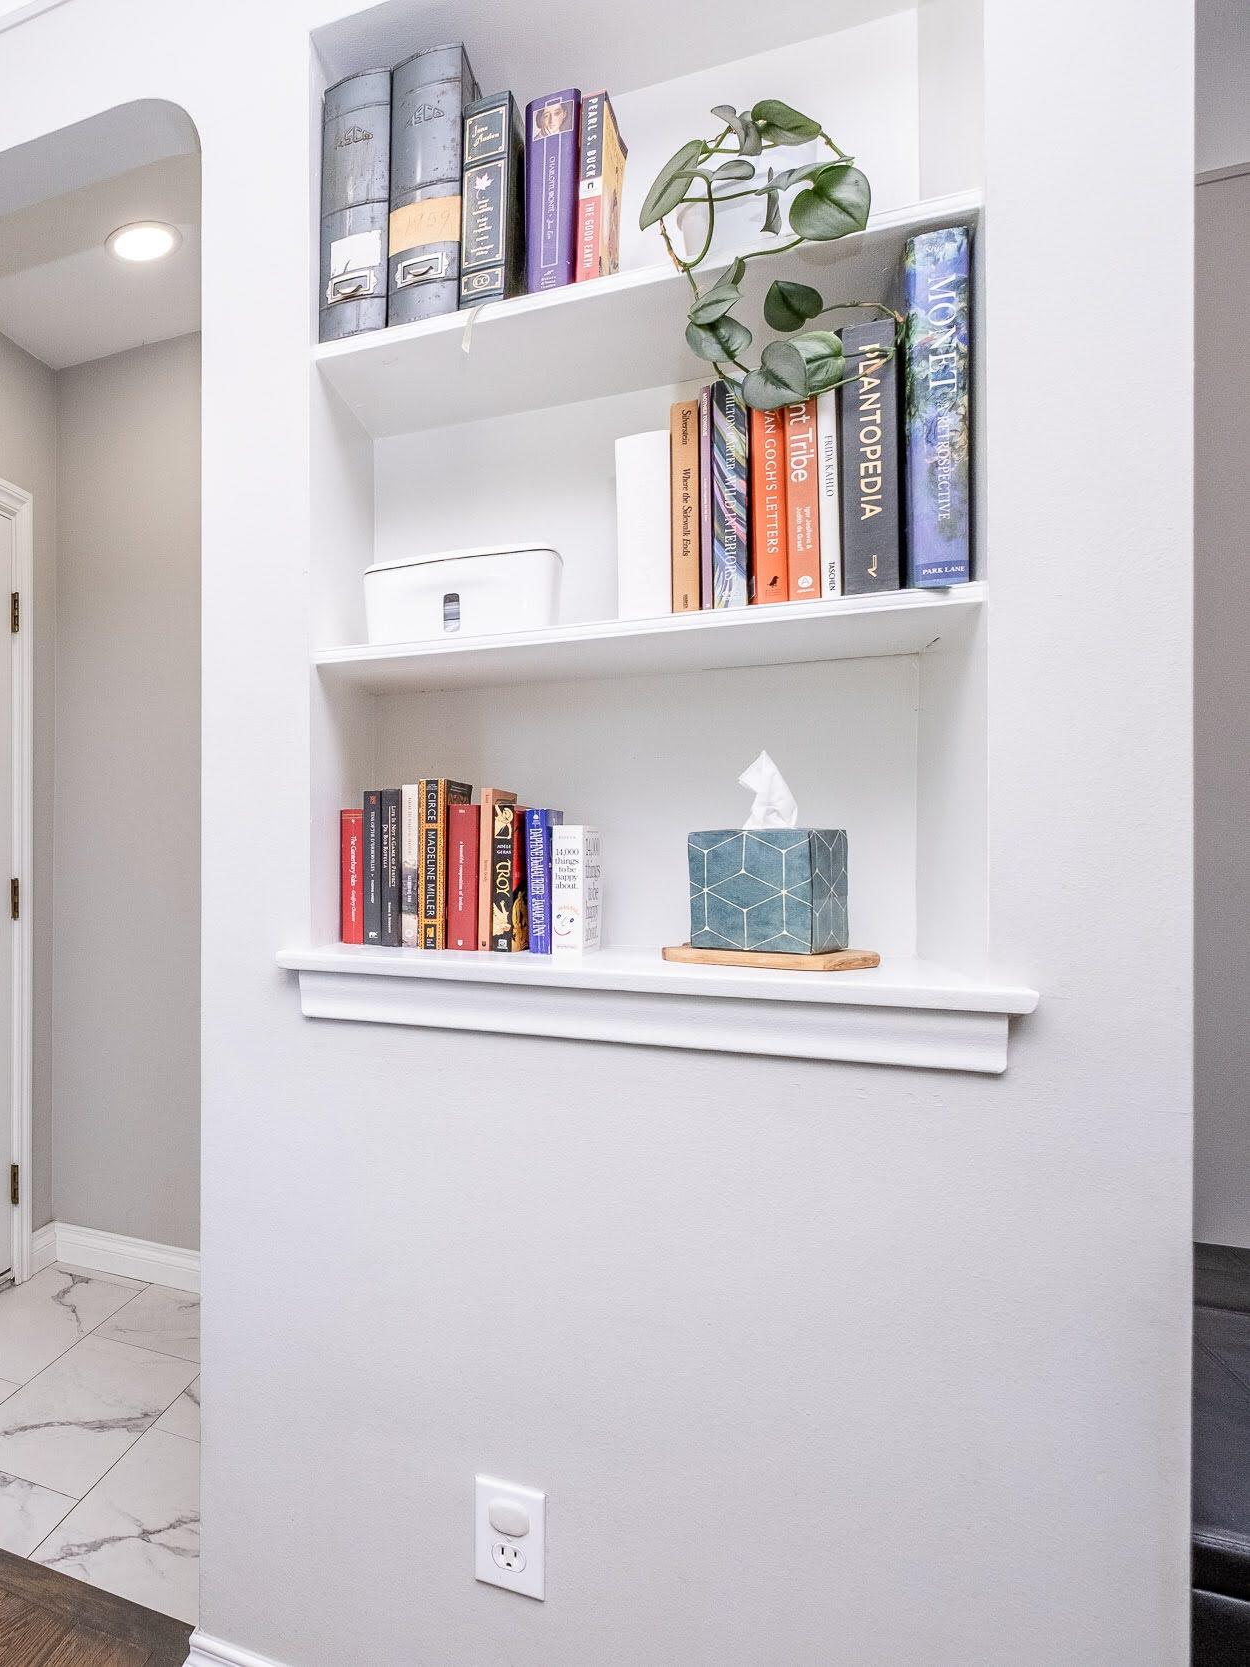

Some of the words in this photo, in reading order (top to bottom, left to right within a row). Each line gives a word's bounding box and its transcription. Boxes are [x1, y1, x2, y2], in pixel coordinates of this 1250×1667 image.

[587, 97, 598, 131] PEARL
[472, 125, 488, 138] Jane
[473, 132, 500, 147] Austen
[587, 136, 596, 146] S.
[585, 150, 596, 177] BUCK
[584, 203, 595, 218] THE
[584, 219, 594, 242] GOOD
[583, 244, 594, 269] EARTH
[927, 273, 957, 394] MONET
[725, 392, 735, 428] HILTON
[789, 403, 811, 426] nt
[937, 403, 948, 412] A
[681, 409, 692, 445] Silverstein
[764, 410, 775, 434] VAN
[858, 342, 882, 521] PLANTOPEDIA
[725, 431, 735, 470] CARTER
[789, 427, 814, 483] Tribe
[824, 435, 833, 461] FRIDA
[764, 438, 777, 490] GOGH'S
[937, 415, 951, 521] RETROSPECTIVE
[682, 468, 691, 491] Where
[725, 475, 736, 509] WILD
[825, 464, 834, 497] KAHLO
[682, 492, 690, 504] the
[682, 505, 692, 537] Sidewalk
[765, 496, 778, 554] LETTERS
[682, 538, 691, 557] Ends
[724, 513, 736, 581] INTERIORS
[828, 561, 836, 591] TASCHEN
[922, 567, 943, 576] PARK
[944, 565, 965, 574] LANE
[427, 792, 436, 821] CIRCE
[530, 828, 543, 856] DAPHNE
[555, 848, 579, 856] 14,000
[349, 846, 357, 874] Canterbury
[427, 831, 436, 882] MADELINE
[555, 857, 579, 865] things
[495, 858, 511, 897] TROY
[555, 873, 578, 881] happy
[427, 884, 436, 917] MILLER
[531, 898, 545, 924] JAMAICA
[532, 924, 546, 937] INN
